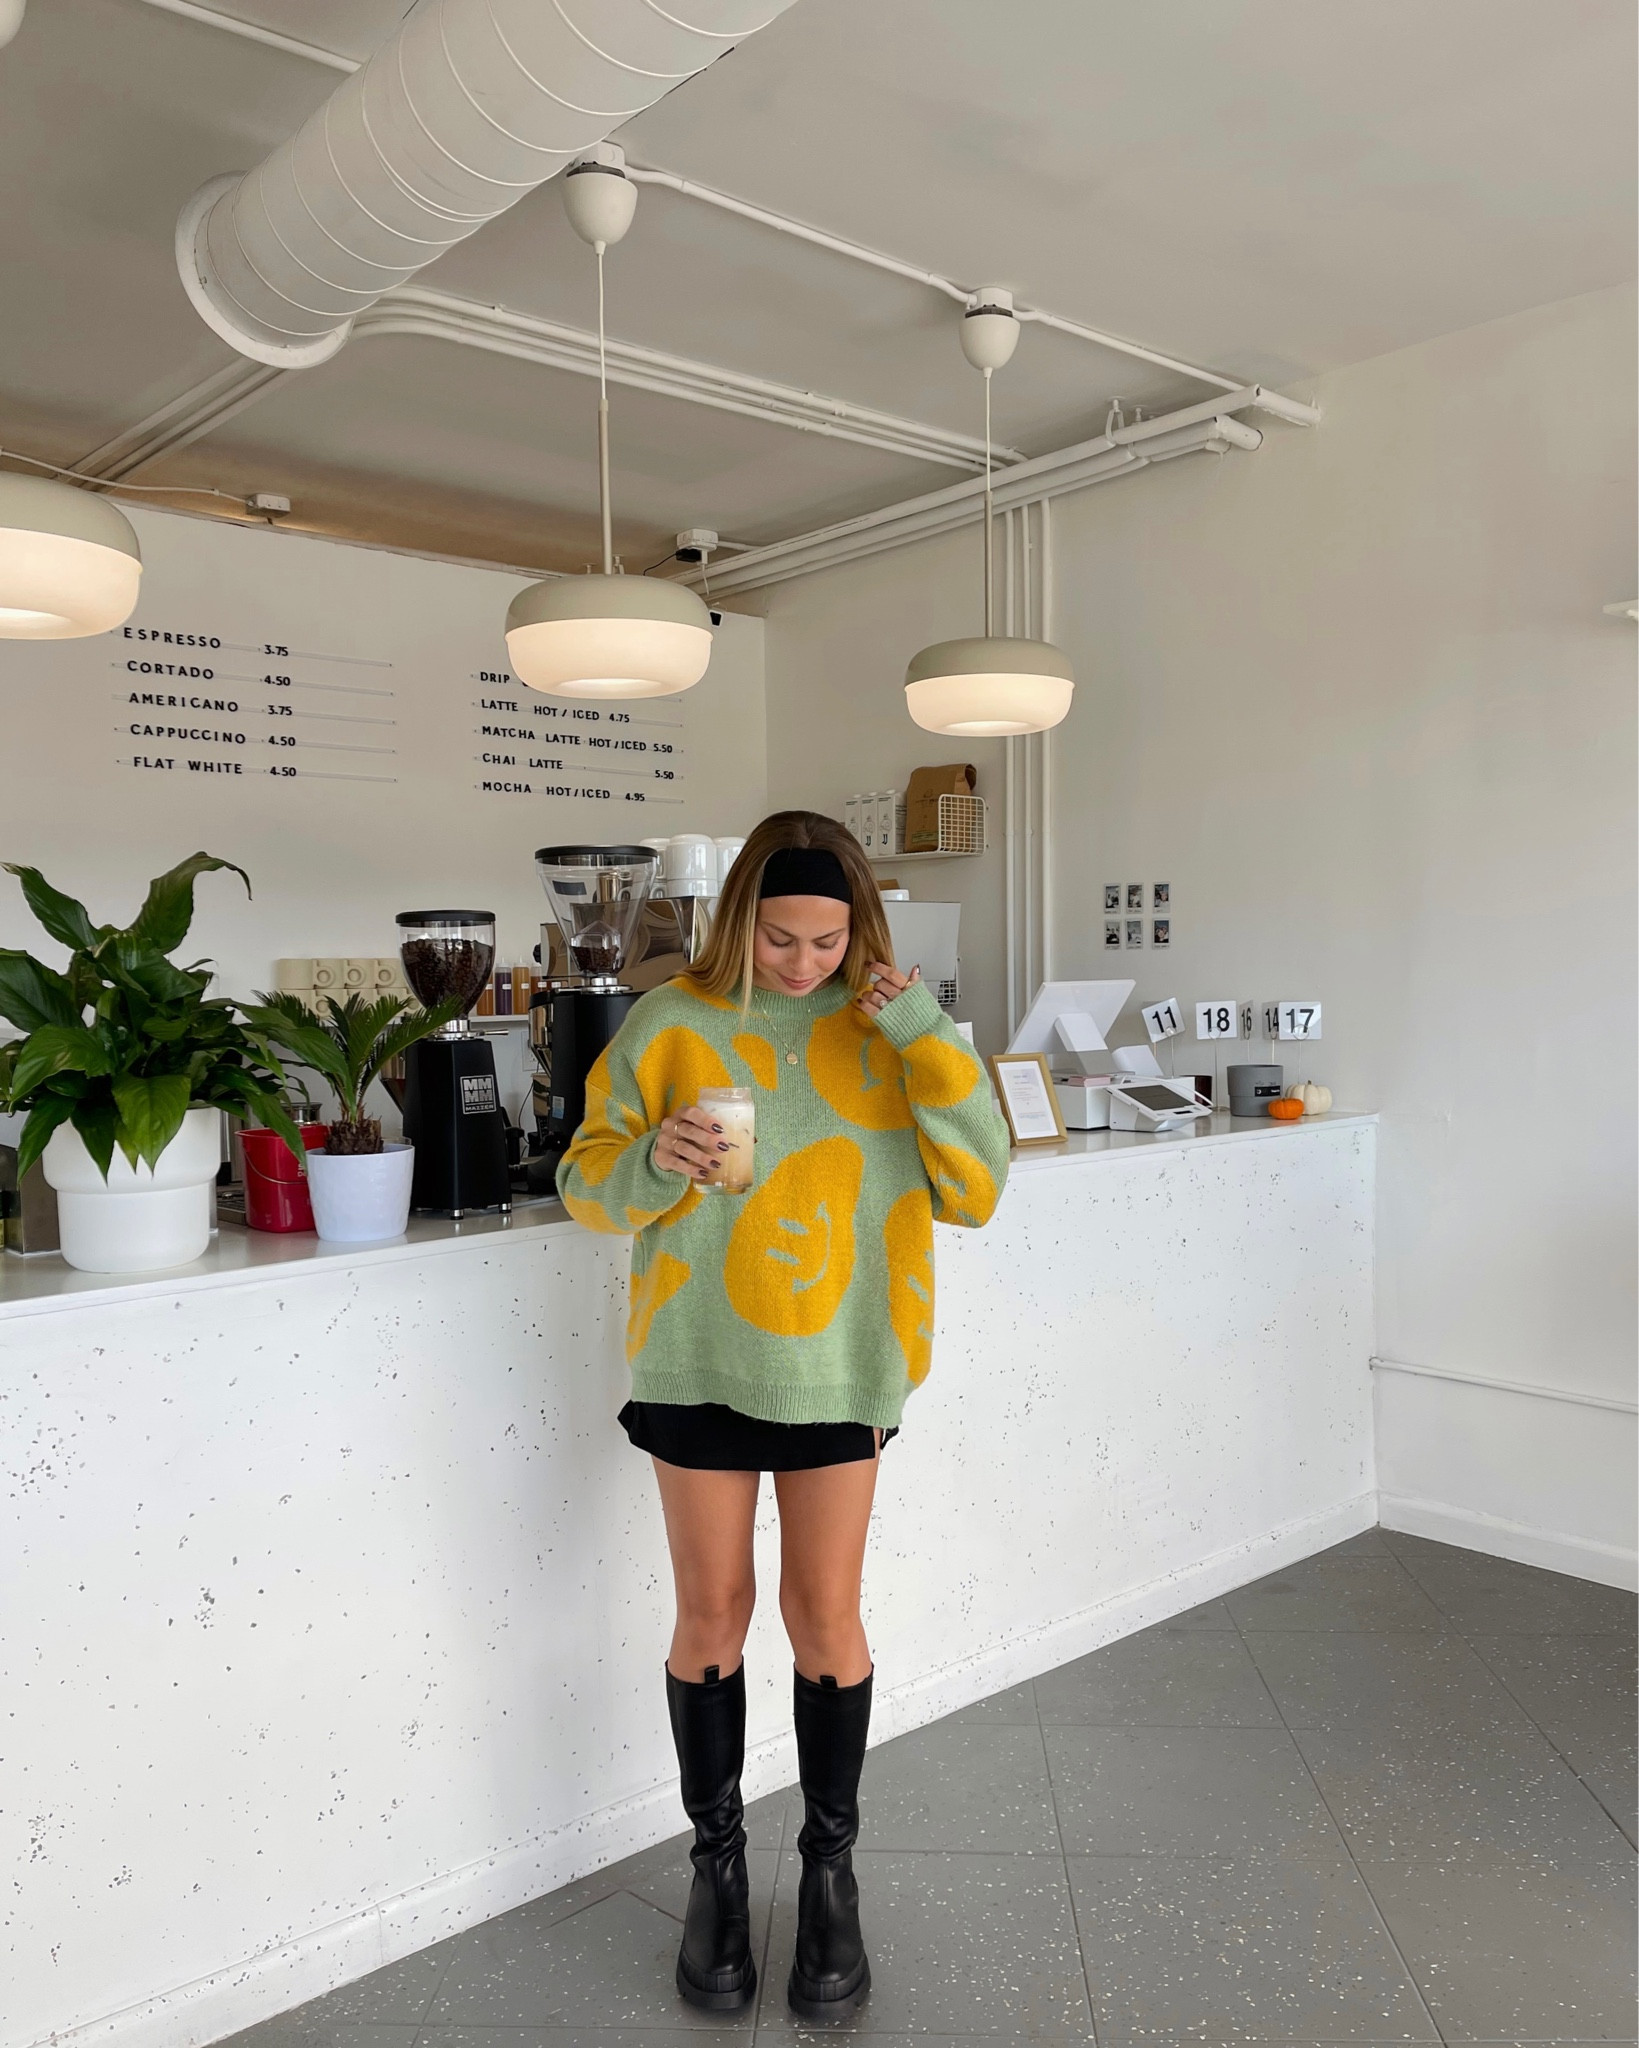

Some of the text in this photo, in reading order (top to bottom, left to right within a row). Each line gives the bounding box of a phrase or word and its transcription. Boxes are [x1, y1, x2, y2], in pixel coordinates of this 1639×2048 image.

[124, 627, 288, 656] ESPRESSO 3.75
[127, 661, 290, 686] CORTADO 4.50
[481, 672, 510, 683] DRIP
[129, 693, 292, 715] AMERICANO 3.75
[482, 699, 518, 711] LATTE
[609, 714, 629, 722] 4.75
[130, 724, 295, 746] CAPPUCCINO 4.50
[483, 726, 535, 739] MATCHA
[546, 734, 580, 745] LATTE
[654, 744, 672, 753] 5.50
[134, 757, 296, 776] FLAT WHITE 4.50
[483, 753, 674, 779] CHAI LATTE 5.50
[483, 782, 531, 793] MOCHA
[625, 793, 645, 801] 4.95
[1152, 1007, 1176, 1033] 11
[1203, 1007, 1230, 1032] 18
[1241, 1007, 1252, 1032] 16
[1286, 1009, 1314, 1033] 17
